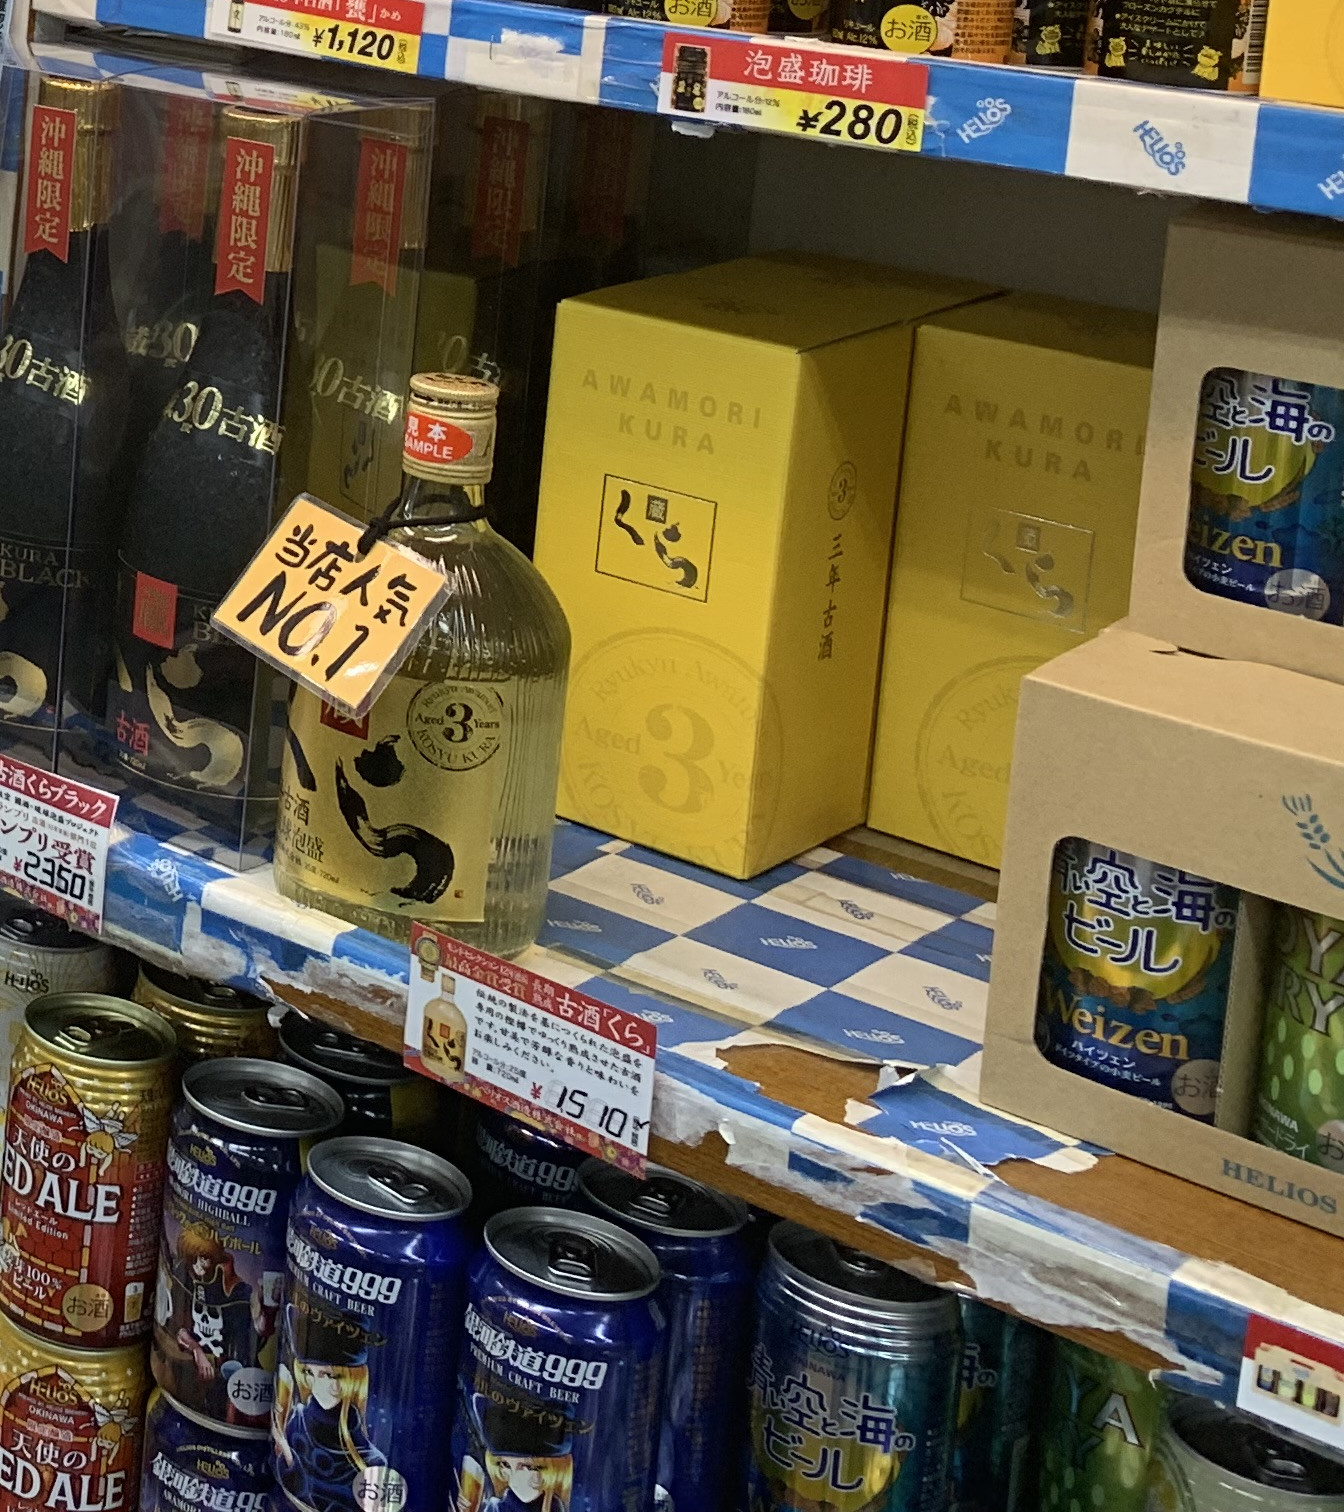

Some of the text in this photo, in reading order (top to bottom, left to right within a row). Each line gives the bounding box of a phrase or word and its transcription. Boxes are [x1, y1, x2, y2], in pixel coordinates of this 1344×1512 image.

[312, 24, 395, 61] ¥1,120
[743, 49, 874, 94] 泡盛珈琲
[33, 115, 68, 246] 沖縄限定
[226, 149, 266, 286] 沖縄限定
[581, 368, 764, 430] AWAMORI
[617, 413, 717, 457] KURA
[983, 440, 1095, 484] KURA
[274, 522, 419, 629] 当店人気
[13, 1128, 77, 1173] 天使の
[1219, 1156, 1339, 1214] HELIOS
